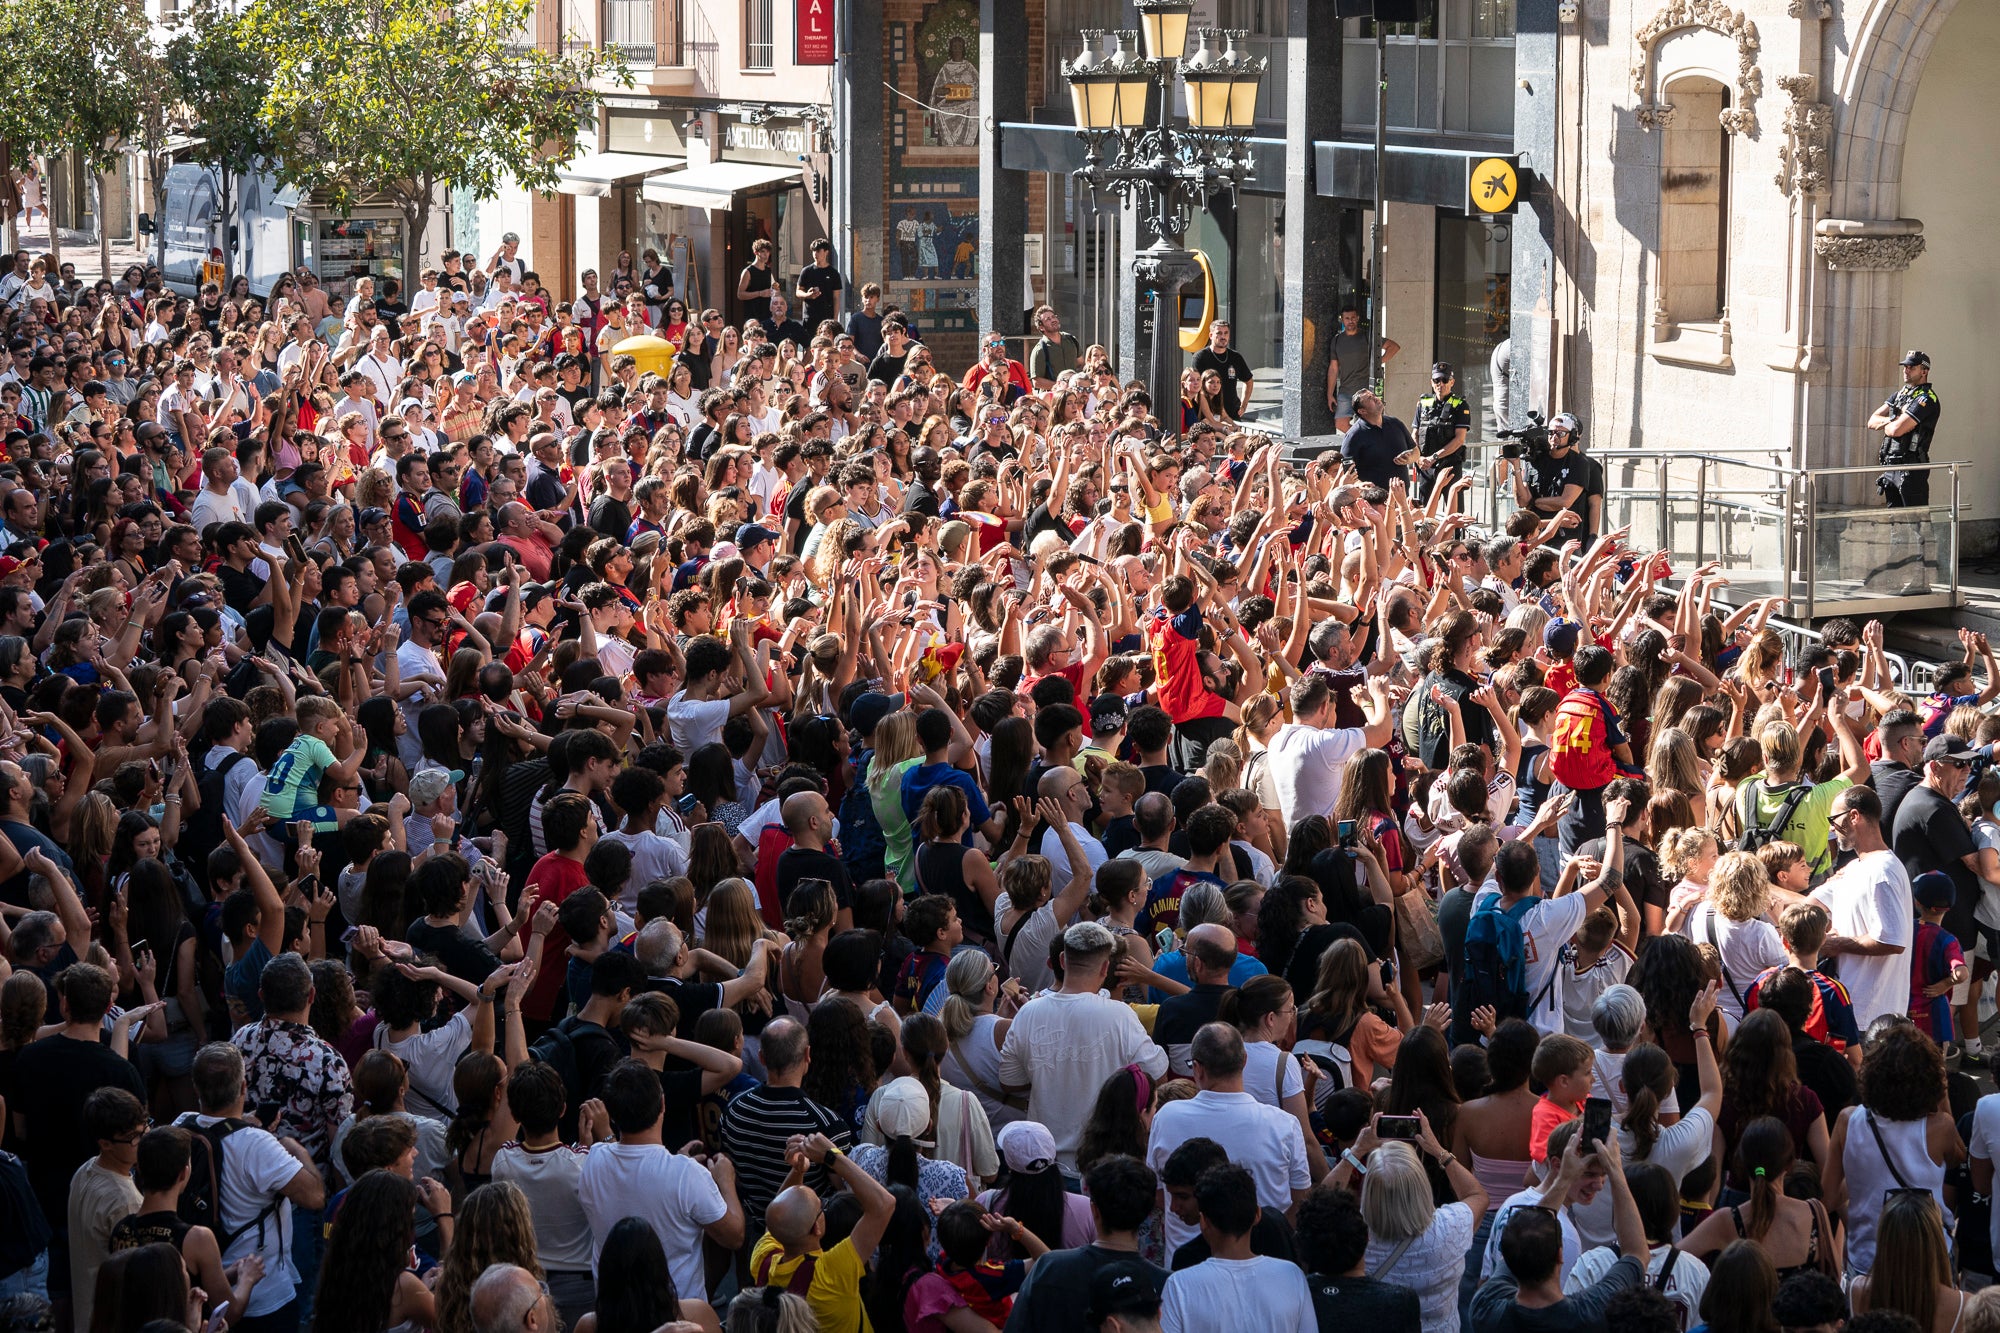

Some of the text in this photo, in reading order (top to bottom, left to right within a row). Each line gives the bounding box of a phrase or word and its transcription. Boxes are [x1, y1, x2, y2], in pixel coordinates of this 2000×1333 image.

[725, 126, 803, 152] AMETLLER ORIGEN
[1565, 680, 1577, 689] OL
[1552, 715, 1594, 754] 24
[1150, 897, 1181, 919] LAMINE
